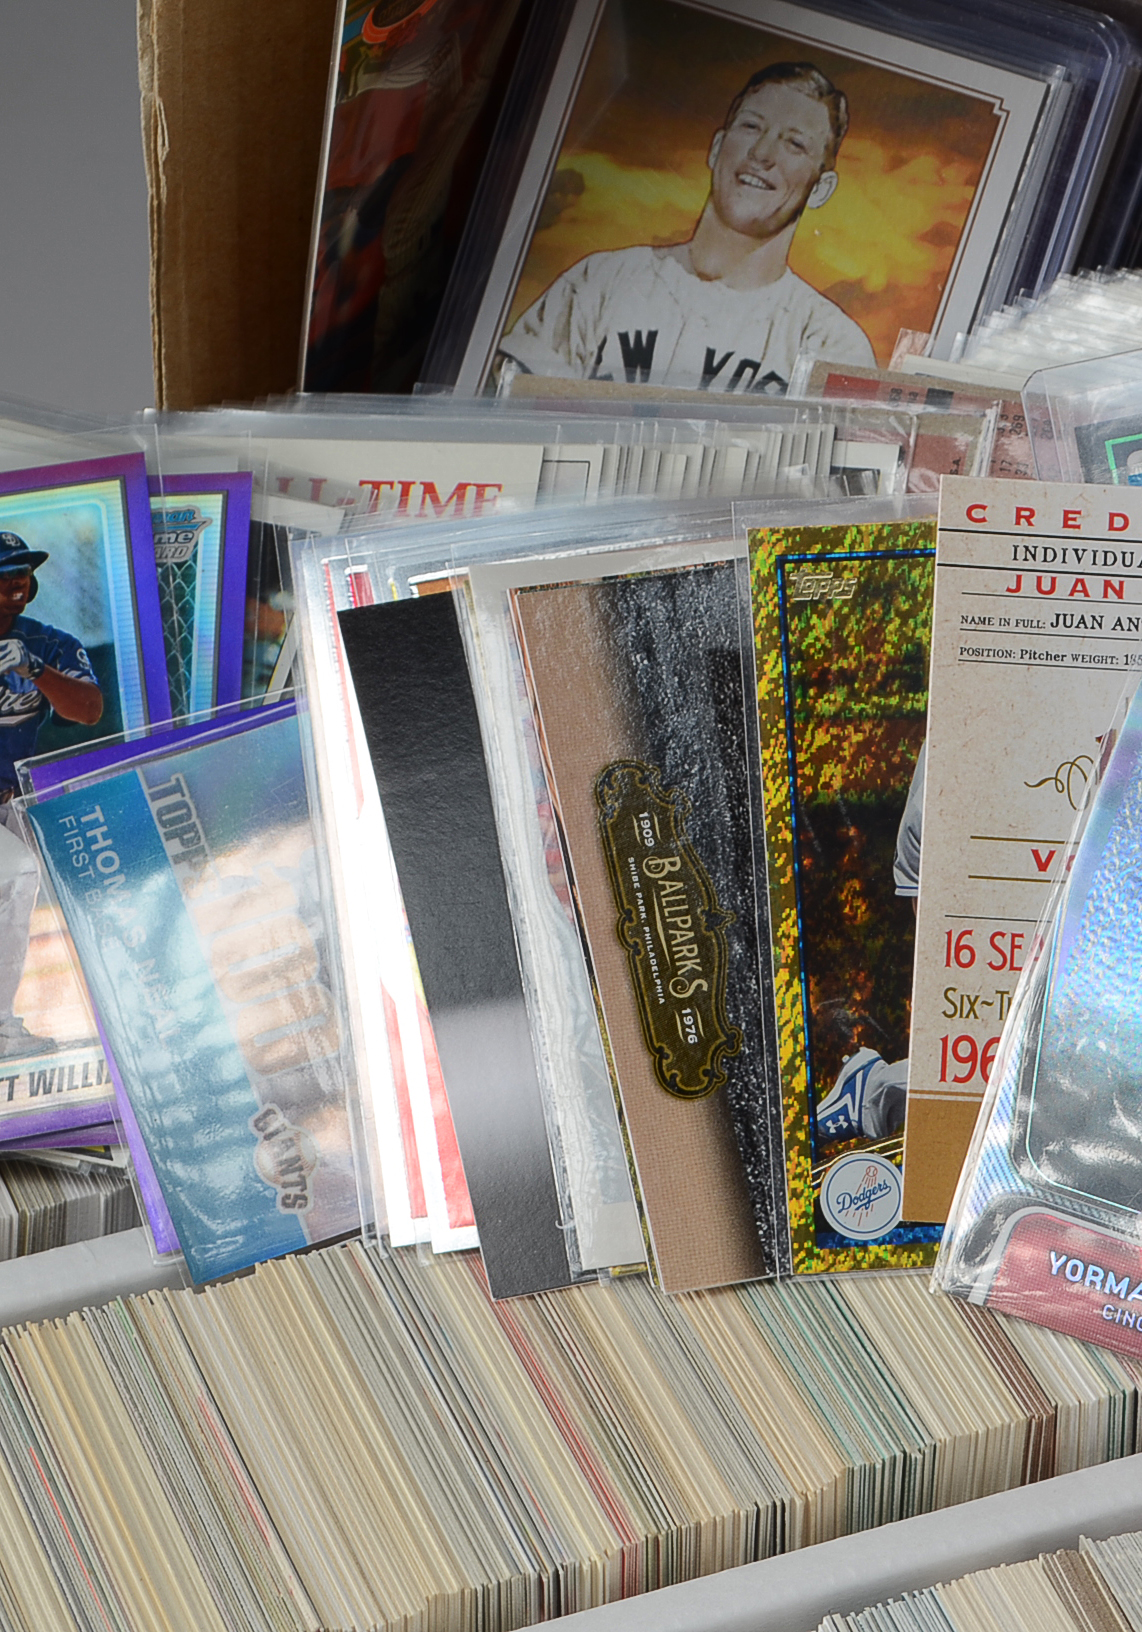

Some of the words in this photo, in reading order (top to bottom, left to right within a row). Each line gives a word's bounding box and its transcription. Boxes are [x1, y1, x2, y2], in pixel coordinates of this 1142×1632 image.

[1005, 574, 1126, 599] JUAN
[960, 614, 995, 627] NAME
[999, 617, 1011, 627] IN
[1014, 619, 1047, 630] FULL:
[1050, 613, 1105, 631] JUAN
[959, 647, 1017, 660] POSITION:
[1019, 649, 1068, 662] Pitcher
[1070, 653, 1120, 666] WEIGHT:
[58, 814, 95, 882] FIRST
[637, 811, 656, 848] 1909
[627, 856, 642, 890] SHIBE
[642, 926, 666, 1006] PHILADELPHIA
[642, 855, 709, 999] BALLPARKS
[944, 928, 978, 970] 16
[680, 1007, 699, 1045] 1976
[836, 1178, 893, 1214] Dodgers
